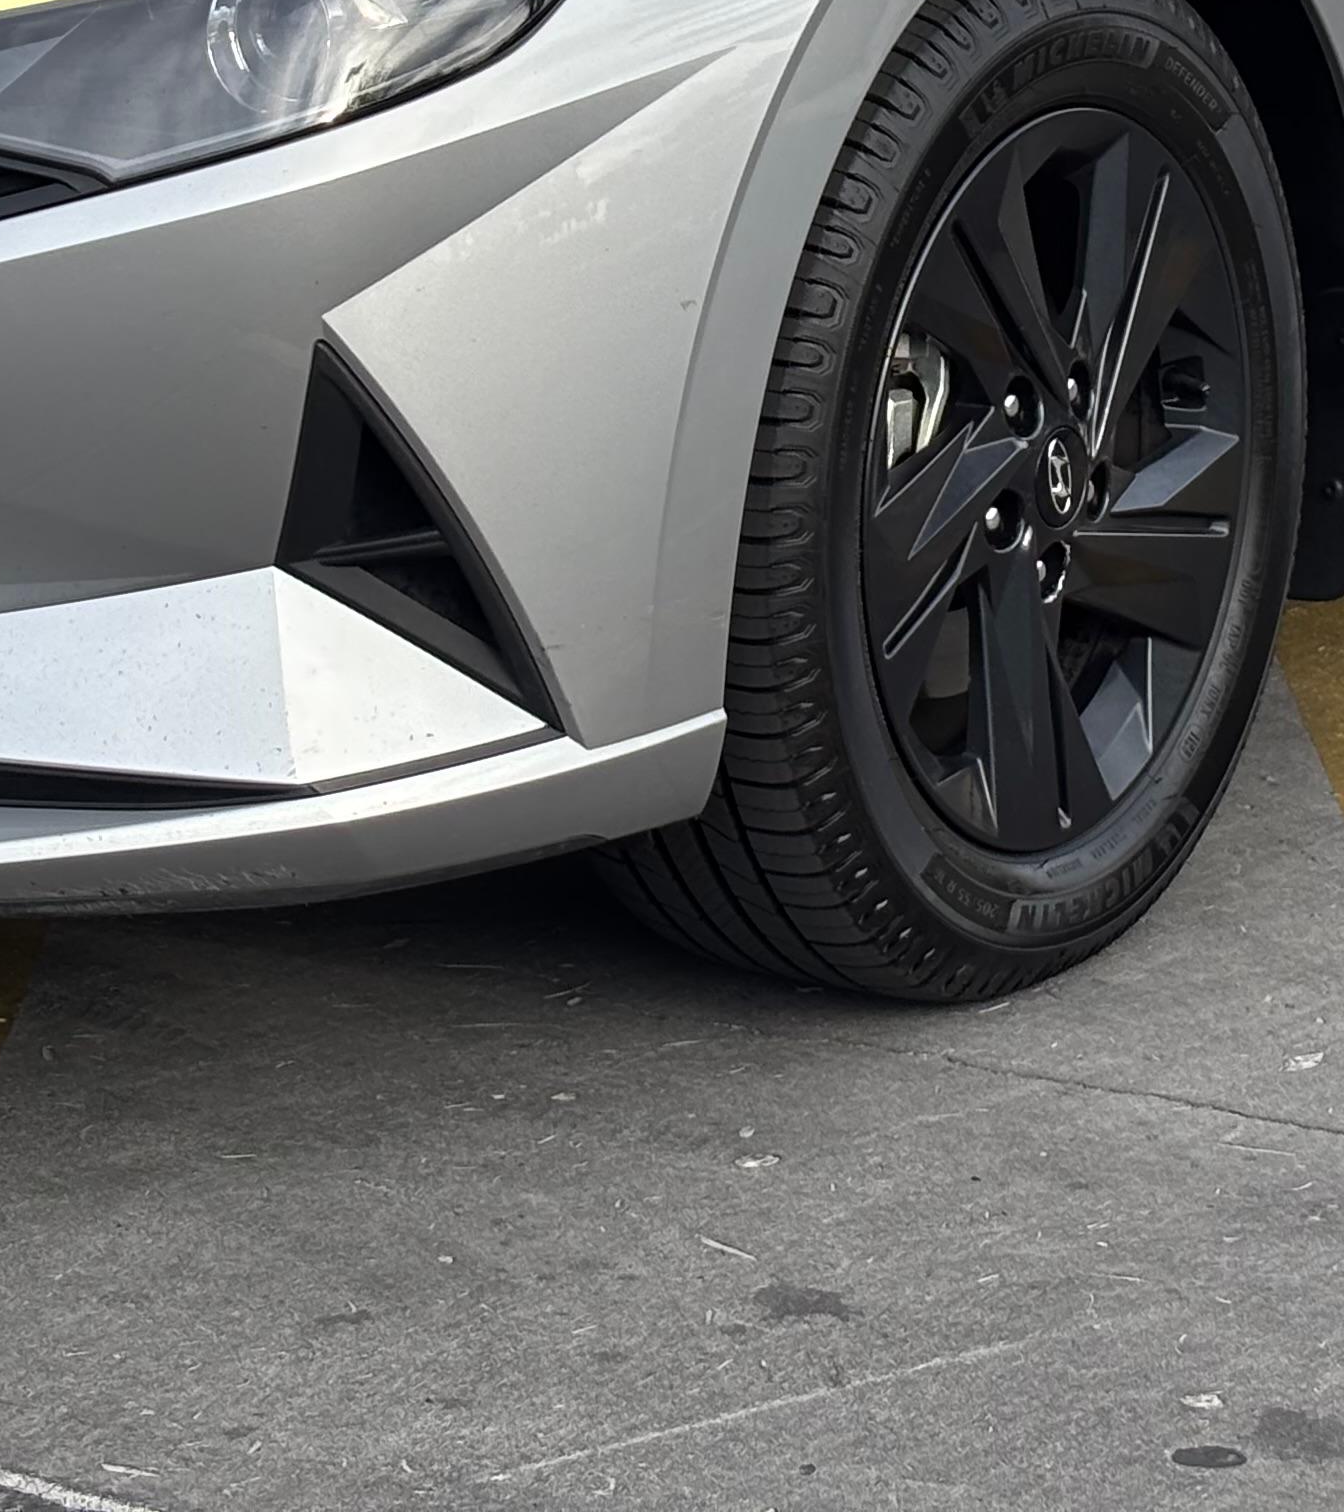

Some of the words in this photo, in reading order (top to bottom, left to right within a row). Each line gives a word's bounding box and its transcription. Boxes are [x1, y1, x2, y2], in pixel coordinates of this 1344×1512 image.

[1013, 29, 1153, 85] MICHELIN
[1164, 56, 1217, 111] DEFENDER
[1014, 853, 1154, 930] MICHELIN
